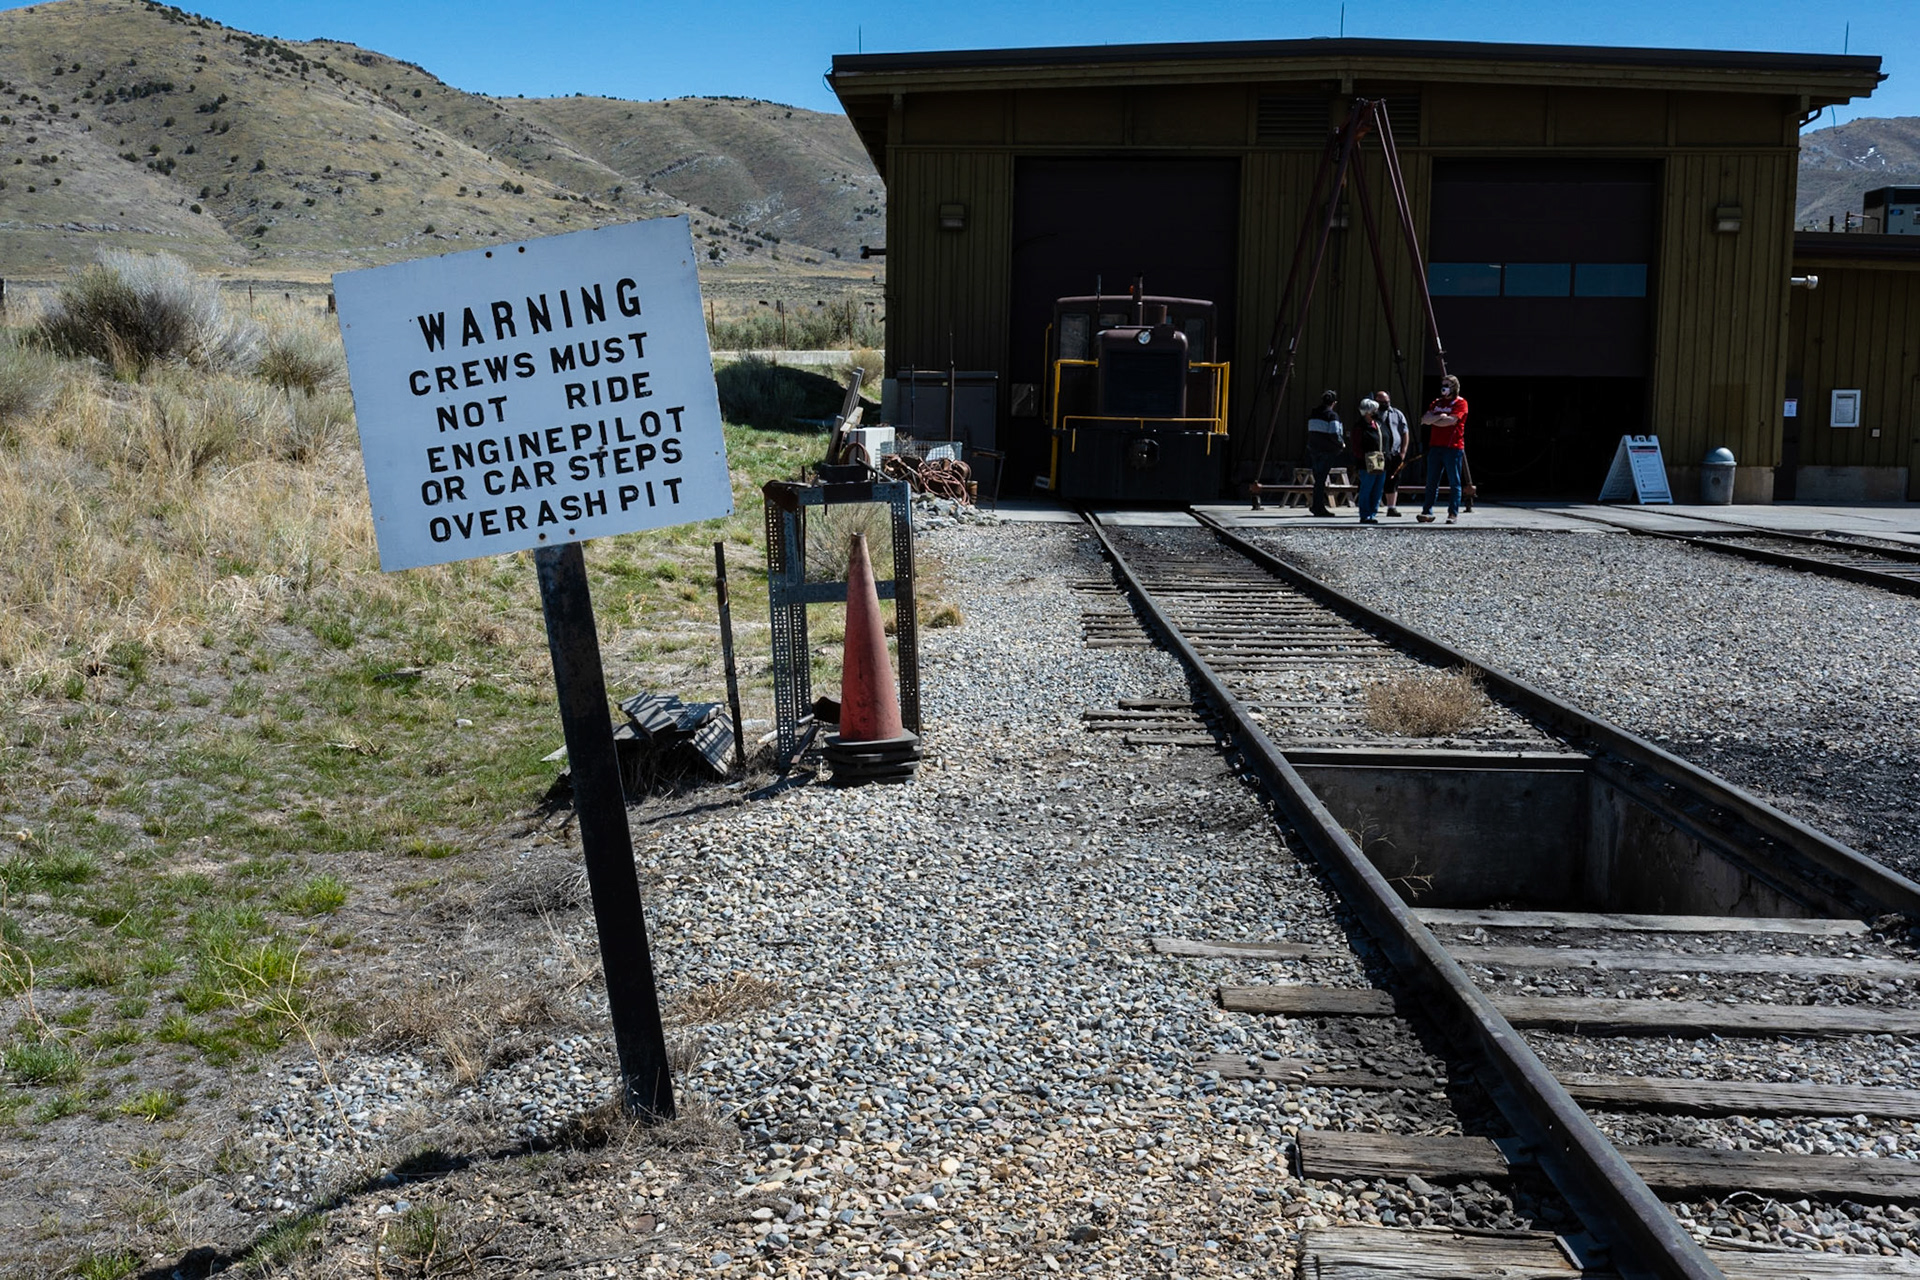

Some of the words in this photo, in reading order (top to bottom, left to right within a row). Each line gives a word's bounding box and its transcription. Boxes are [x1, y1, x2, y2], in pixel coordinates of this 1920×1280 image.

[416, 277, 642, 353] WARNING
[408, 352, 536, 397] CREWS
[549, 331, 648, 374] MUST
[435, 395, 508, 433] NOT
[564, 371, 653, 410] RIDE
[421, 475, 468, 506] OR
[483, 460, 558, 496] CAR
[568, 437, 683, 482] STEPS
[429, 505, 529, 543] OVER
[537, 489, 608, 527] ASH
[618, 477, 683, 512] PIT
